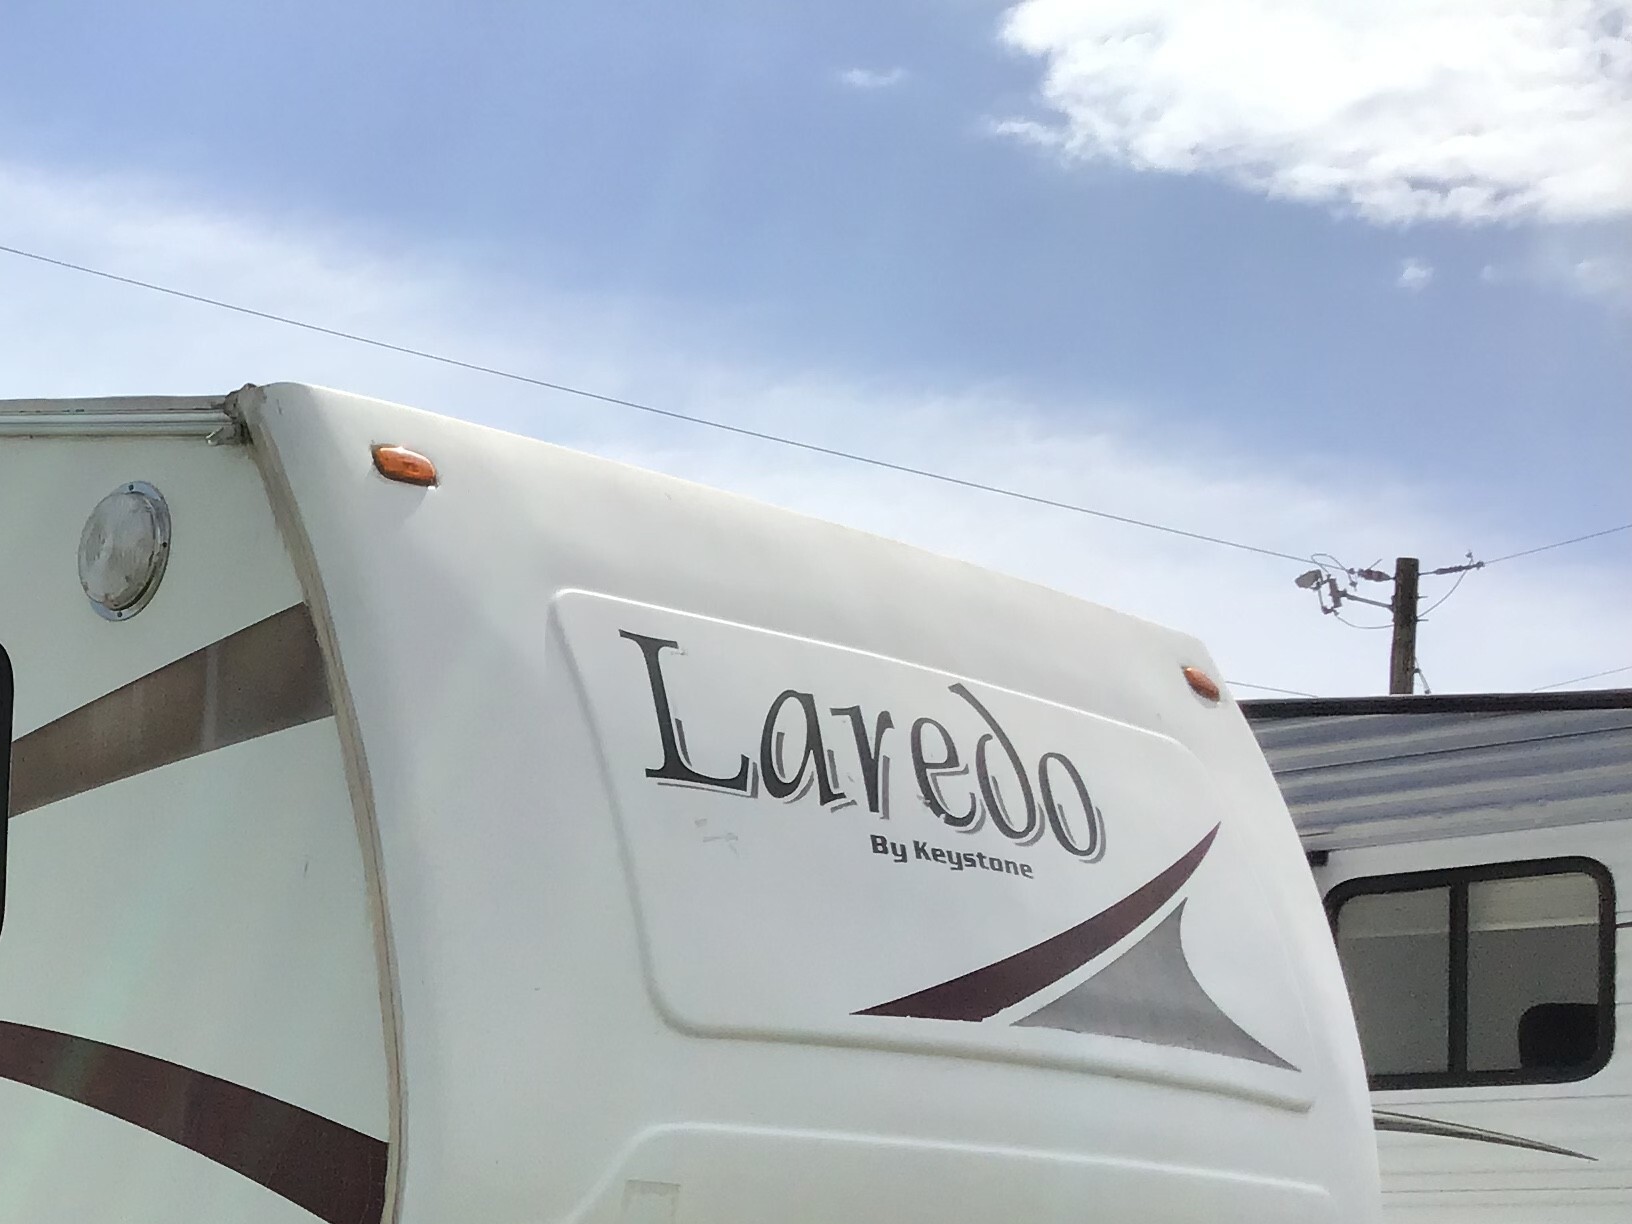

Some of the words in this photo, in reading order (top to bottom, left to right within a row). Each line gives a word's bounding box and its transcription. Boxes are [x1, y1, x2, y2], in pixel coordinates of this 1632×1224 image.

[619, 629, 1106, 864] Laredo
[870, 834, 908, 863] By
[913, 840, 1035, 880] Keystone
